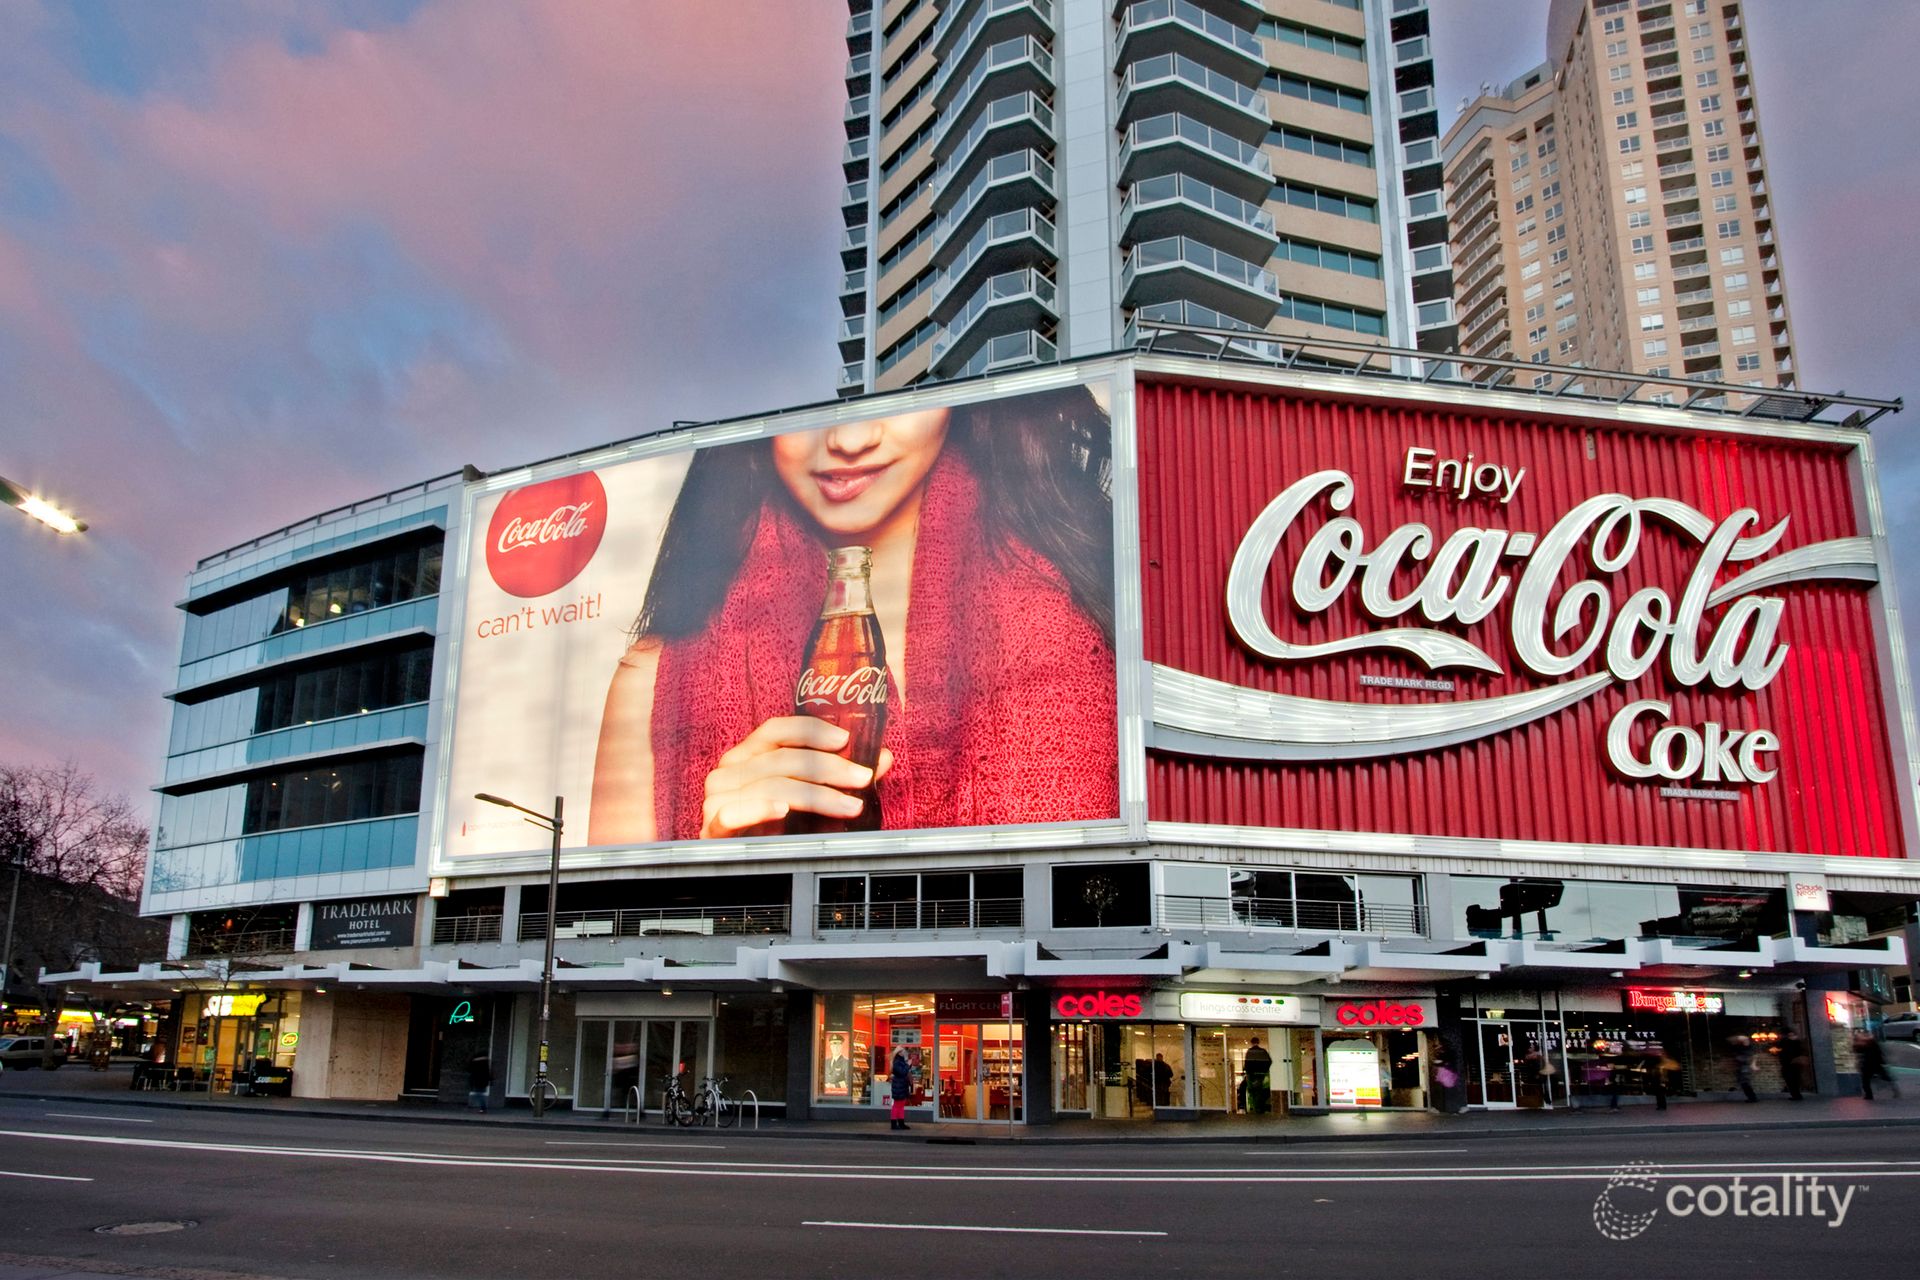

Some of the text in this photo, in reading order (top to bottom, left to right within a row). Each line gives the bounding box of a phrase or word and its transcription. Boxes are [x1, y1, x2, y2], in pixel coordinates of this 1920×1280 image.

[1403, 447, 1526, 503] Enjoy
[498, 501, 593, 553] Coca-Cola
[1227, 469, 1791, 691] Coca-Cola
[477, 592, 602, 639] can't wait!
[796, 666, 888, 706] Coca-Cola
[1361, 675, 1393, 686] TRADE
[1395, 678, 1425, 688] MARK
[1607, 699, 1781, 783] Coke
[1662, 788, 1689, 797] TRADE
[1690, 789, 1714, 798] MARK
[321, 900, 413, 919] TRADEMARK
[349, 920, 380, 930] HOTEL
[939, 1002, 978, 1010] FLIGHT
[1057, 991, 1144, 1017] coles
[1200, 1003, 1281, 1014] kings cross centre
[1337, 1000, 1424, 1026] coles
